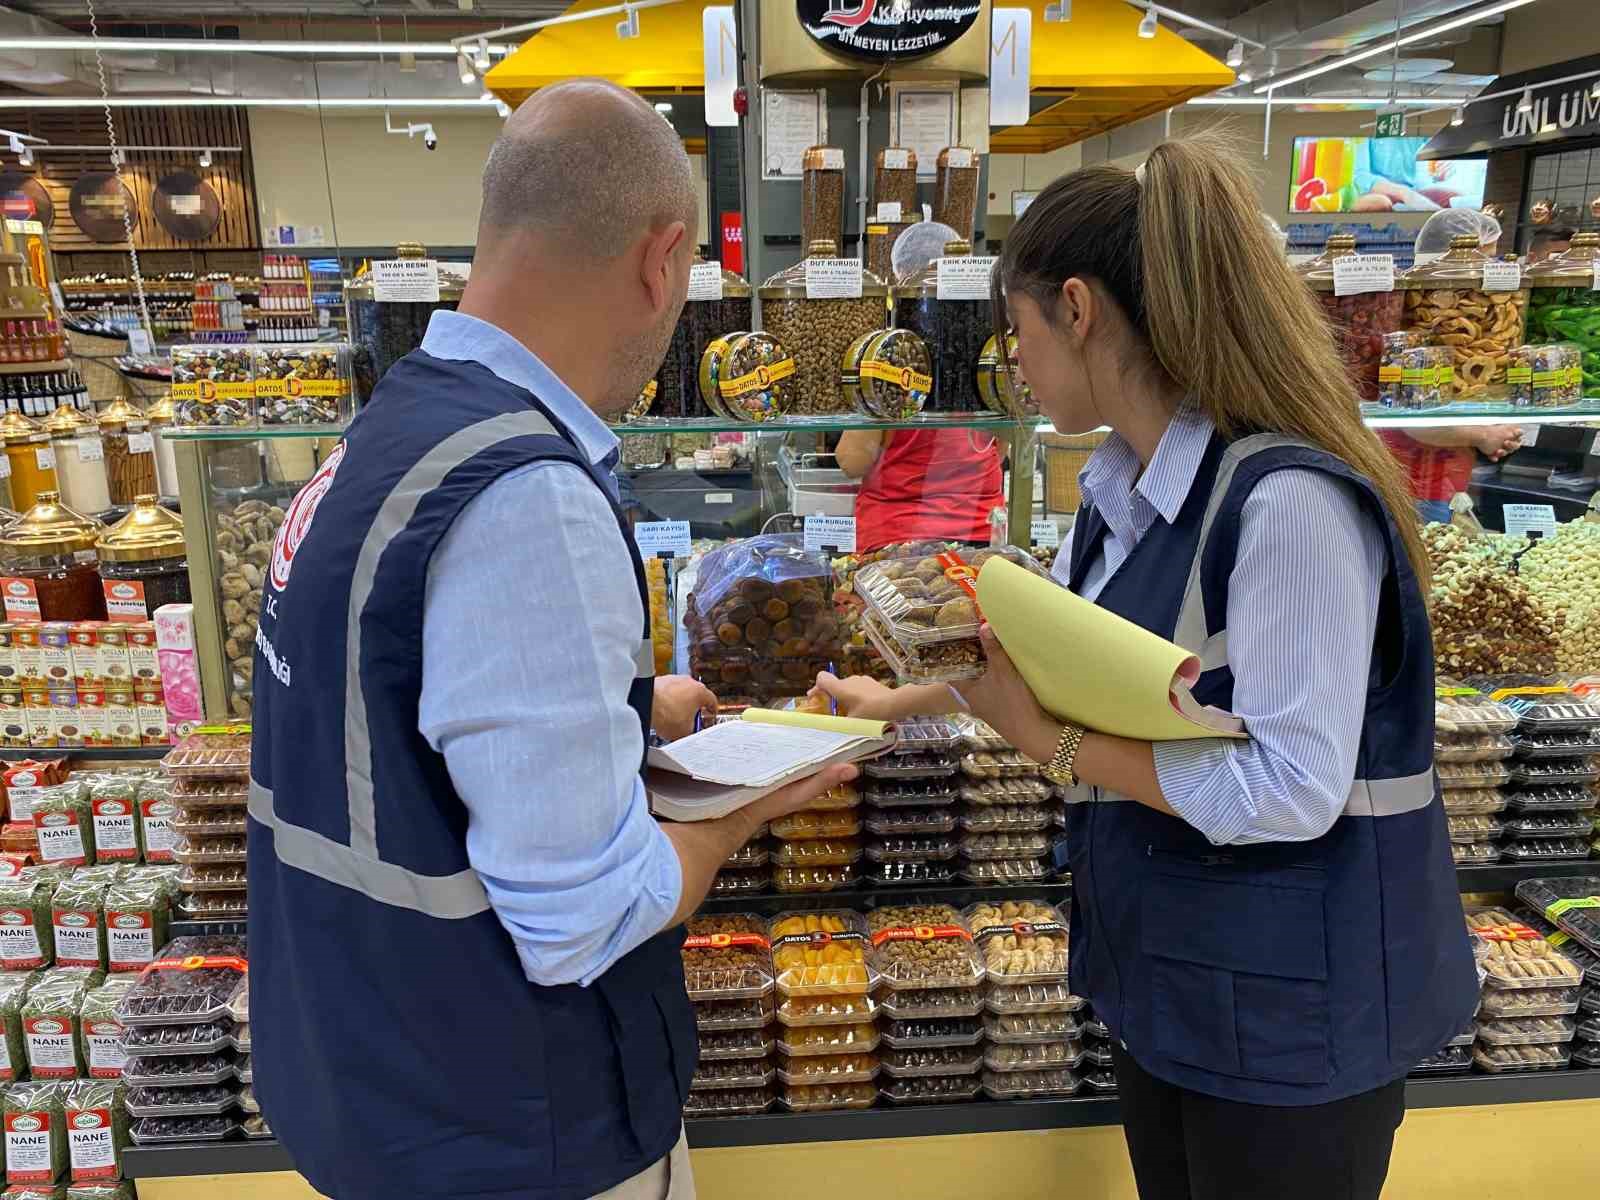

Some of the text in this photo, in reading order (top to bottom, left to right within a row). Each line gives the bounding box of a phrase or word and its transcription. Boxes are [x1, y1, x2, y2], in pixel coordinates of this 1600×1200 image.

[173, 388, 197, 397] DATOS
[258, 385, 283, 393] DATOS
[98, 819, 131, 827] NANE
[43, 829, 77, 838] NANE
[0, 929, 32, 937] NANE
[59, 930, 94, 938] NANE
[113, 932, 149, 940] NANE
[784, 935, 811, 943] DATOS
[32, 1038, 69, 1046] NANE
[11, 1135, 47, 1144] NANE
[73, 1132, 109, 1142] NANE
